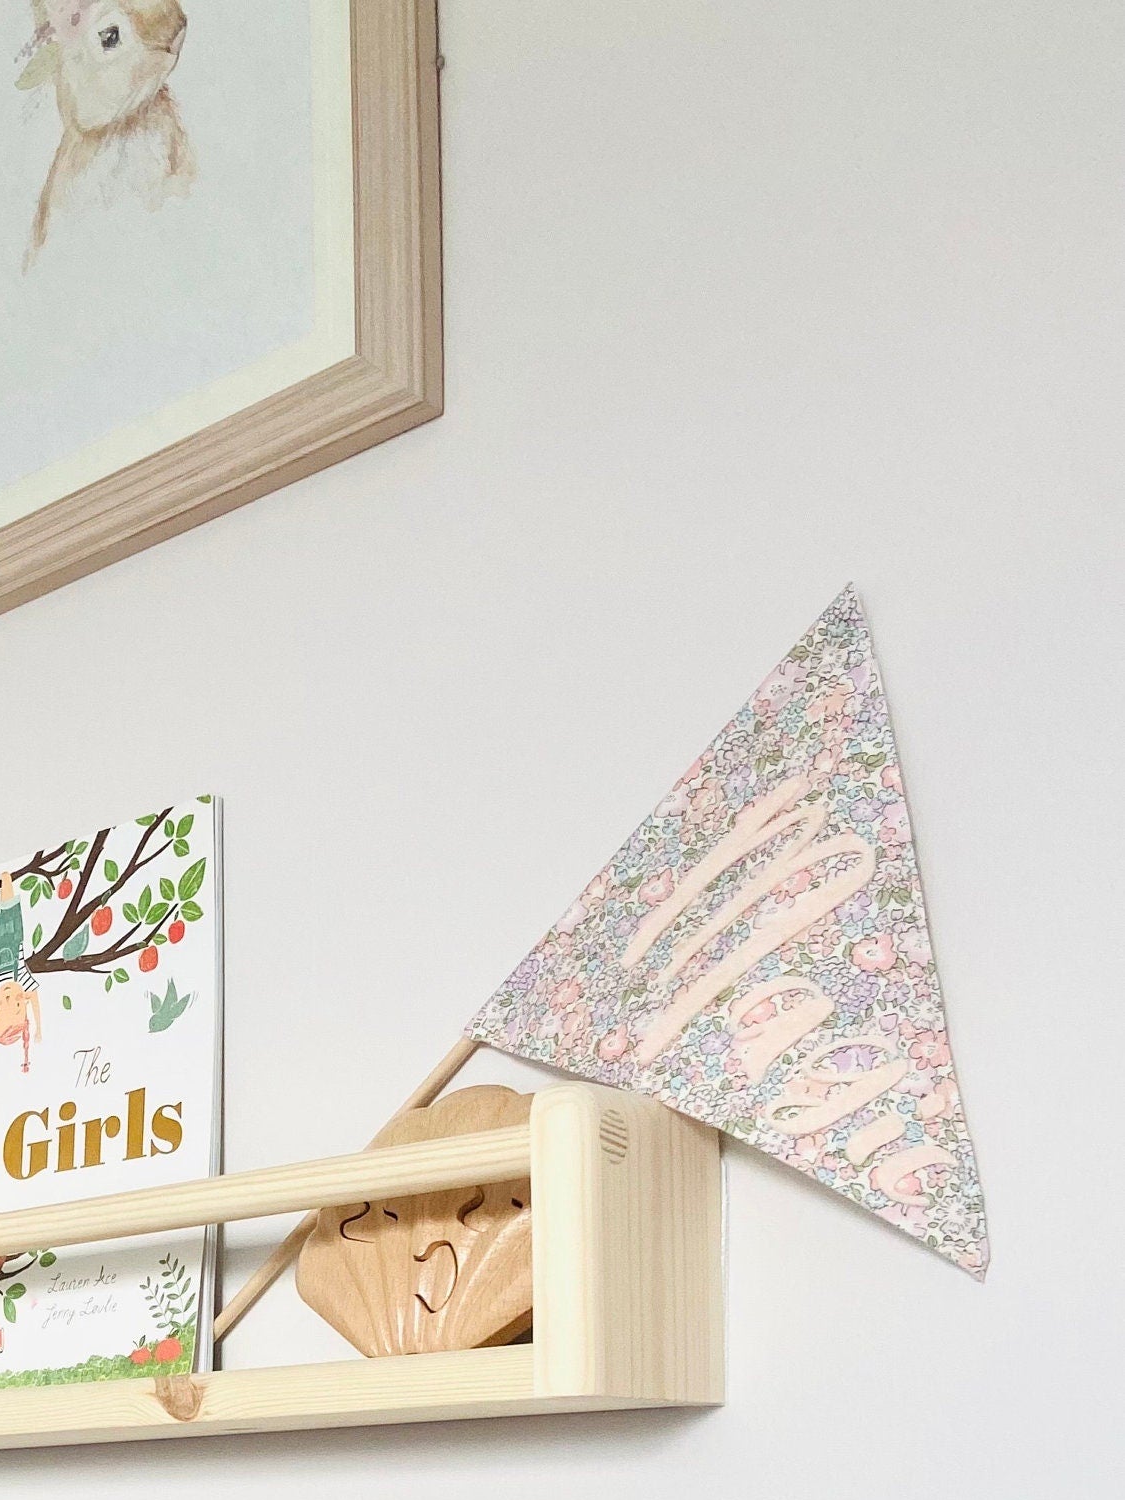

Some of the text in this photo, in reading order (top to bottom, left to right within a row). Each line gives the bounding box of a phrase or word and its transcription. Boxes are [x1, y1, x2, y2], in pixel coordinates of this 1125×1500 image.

[73, 1046, 111, 1088] The
[3, 1087, 183, 1180] Girls
[47, 1265, 117, 1294] Lauren Ace
